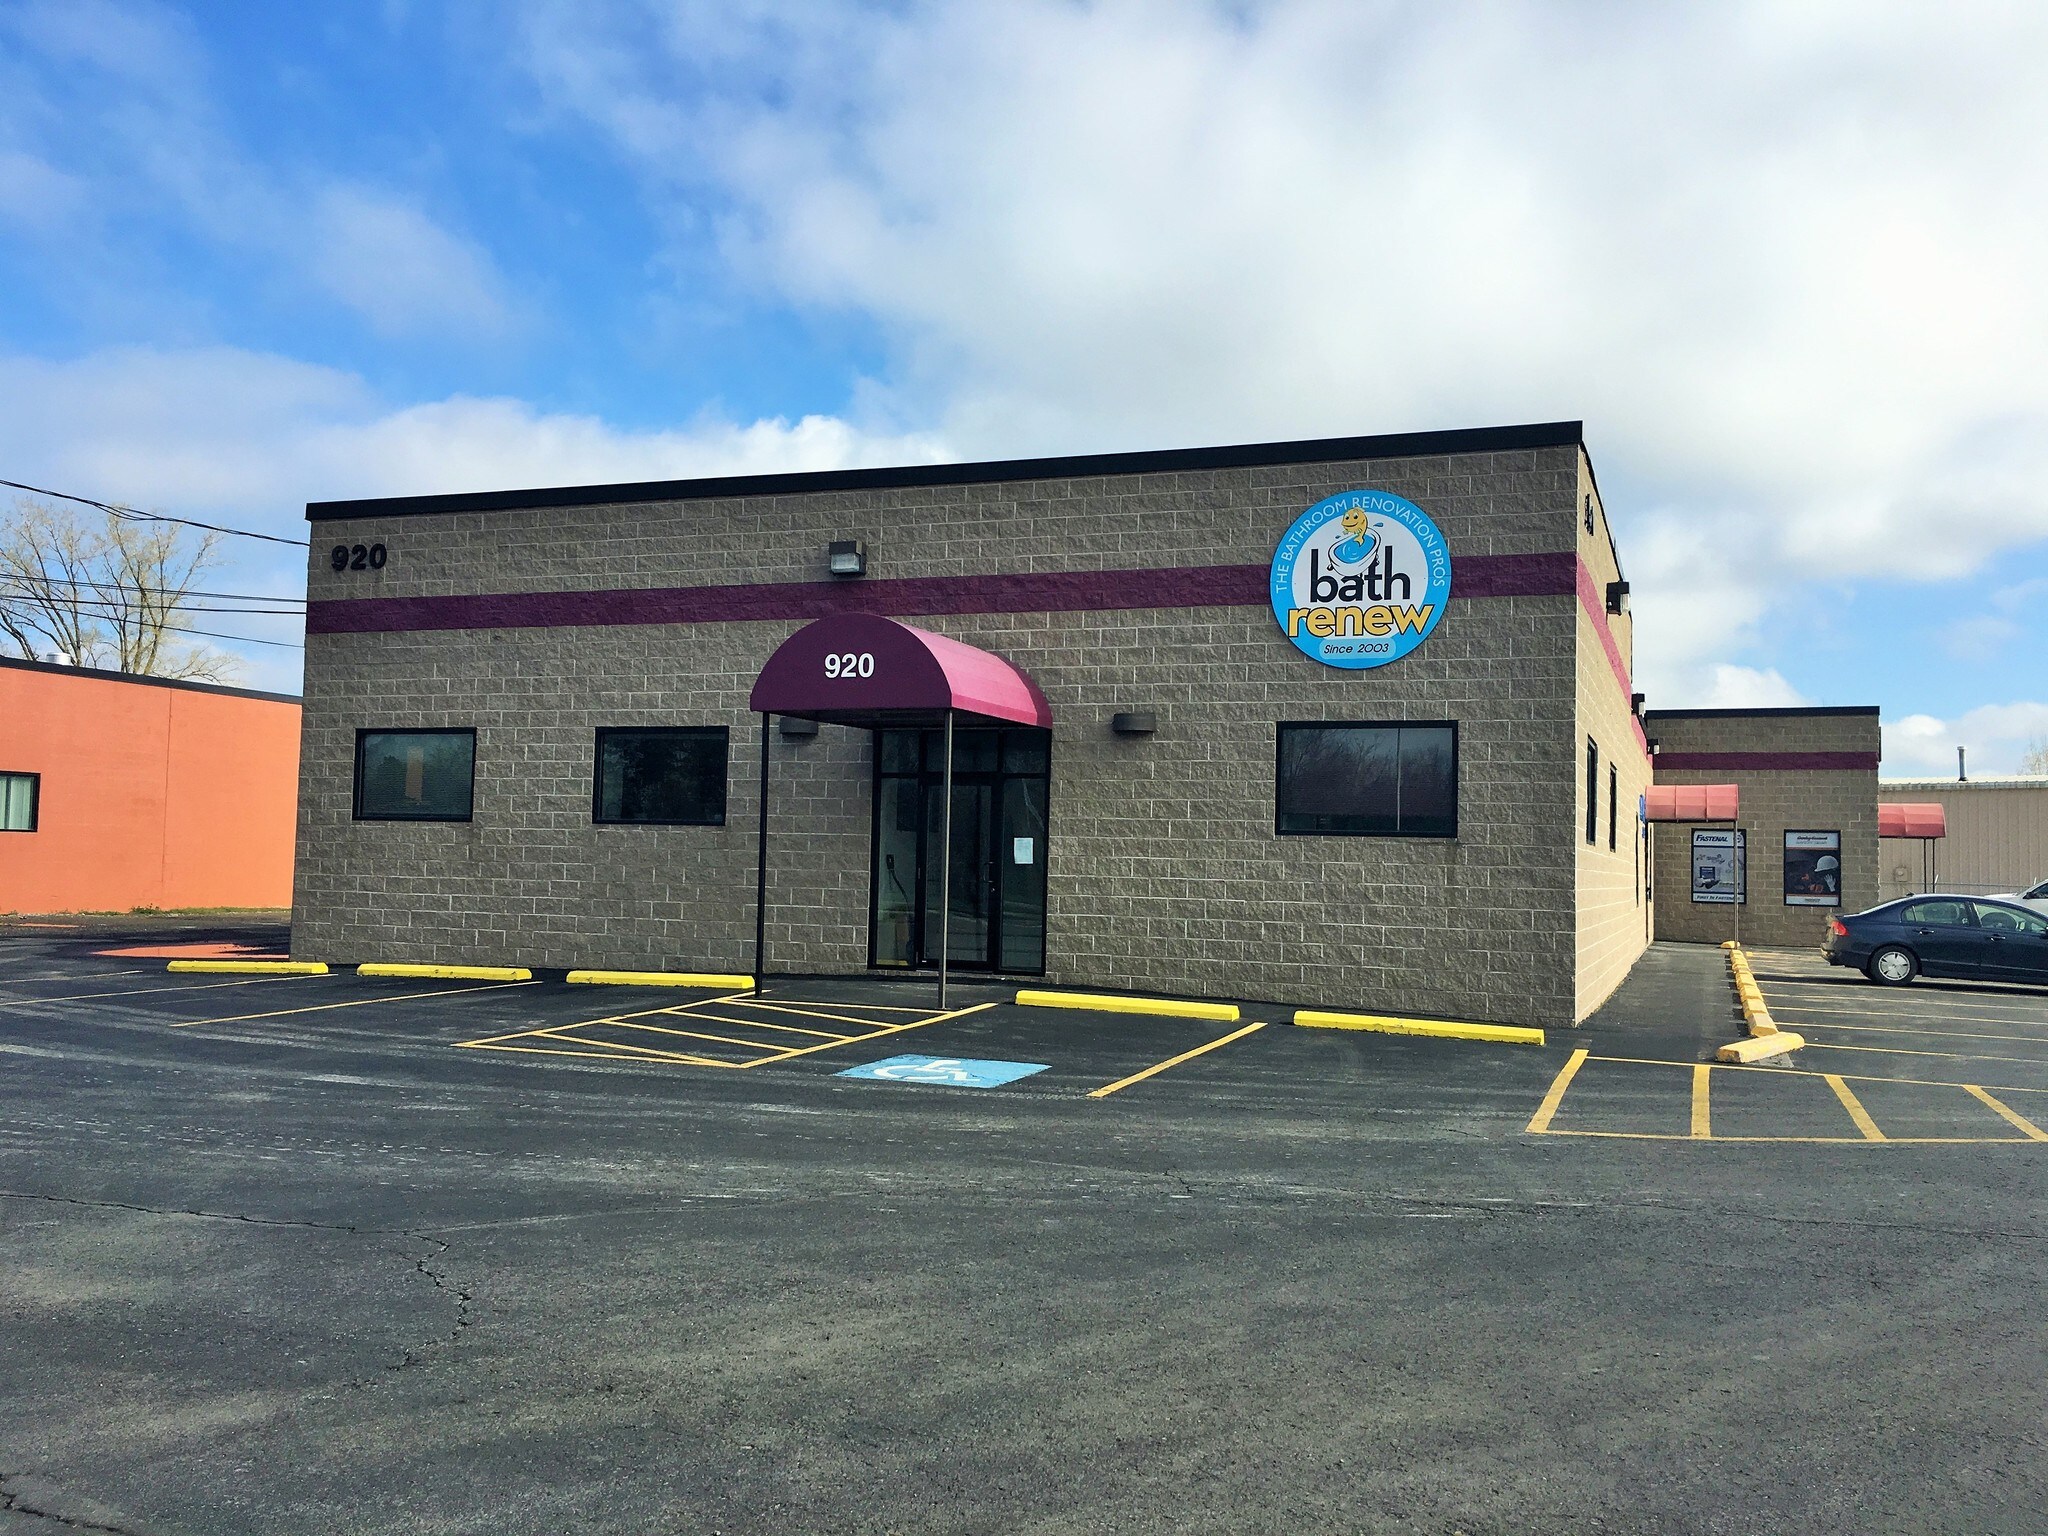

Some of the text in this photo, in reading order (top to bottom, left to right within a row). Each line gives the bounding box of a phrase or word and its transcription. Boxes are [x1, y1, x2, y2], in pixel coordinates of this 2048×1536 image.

[331, 543, 388, 571] 920
[1276, 497, 1446, 594] THE BATHROOM RENOVATION PROS
[1310, 545, 1411, 603] bath
[1287, 604, 1435, 638] renew
[1323, 643, 1389, 654] Since 2003
[824, 652, 875, 679] 920
[1696, 834, 1728, 842] FASTENAL
